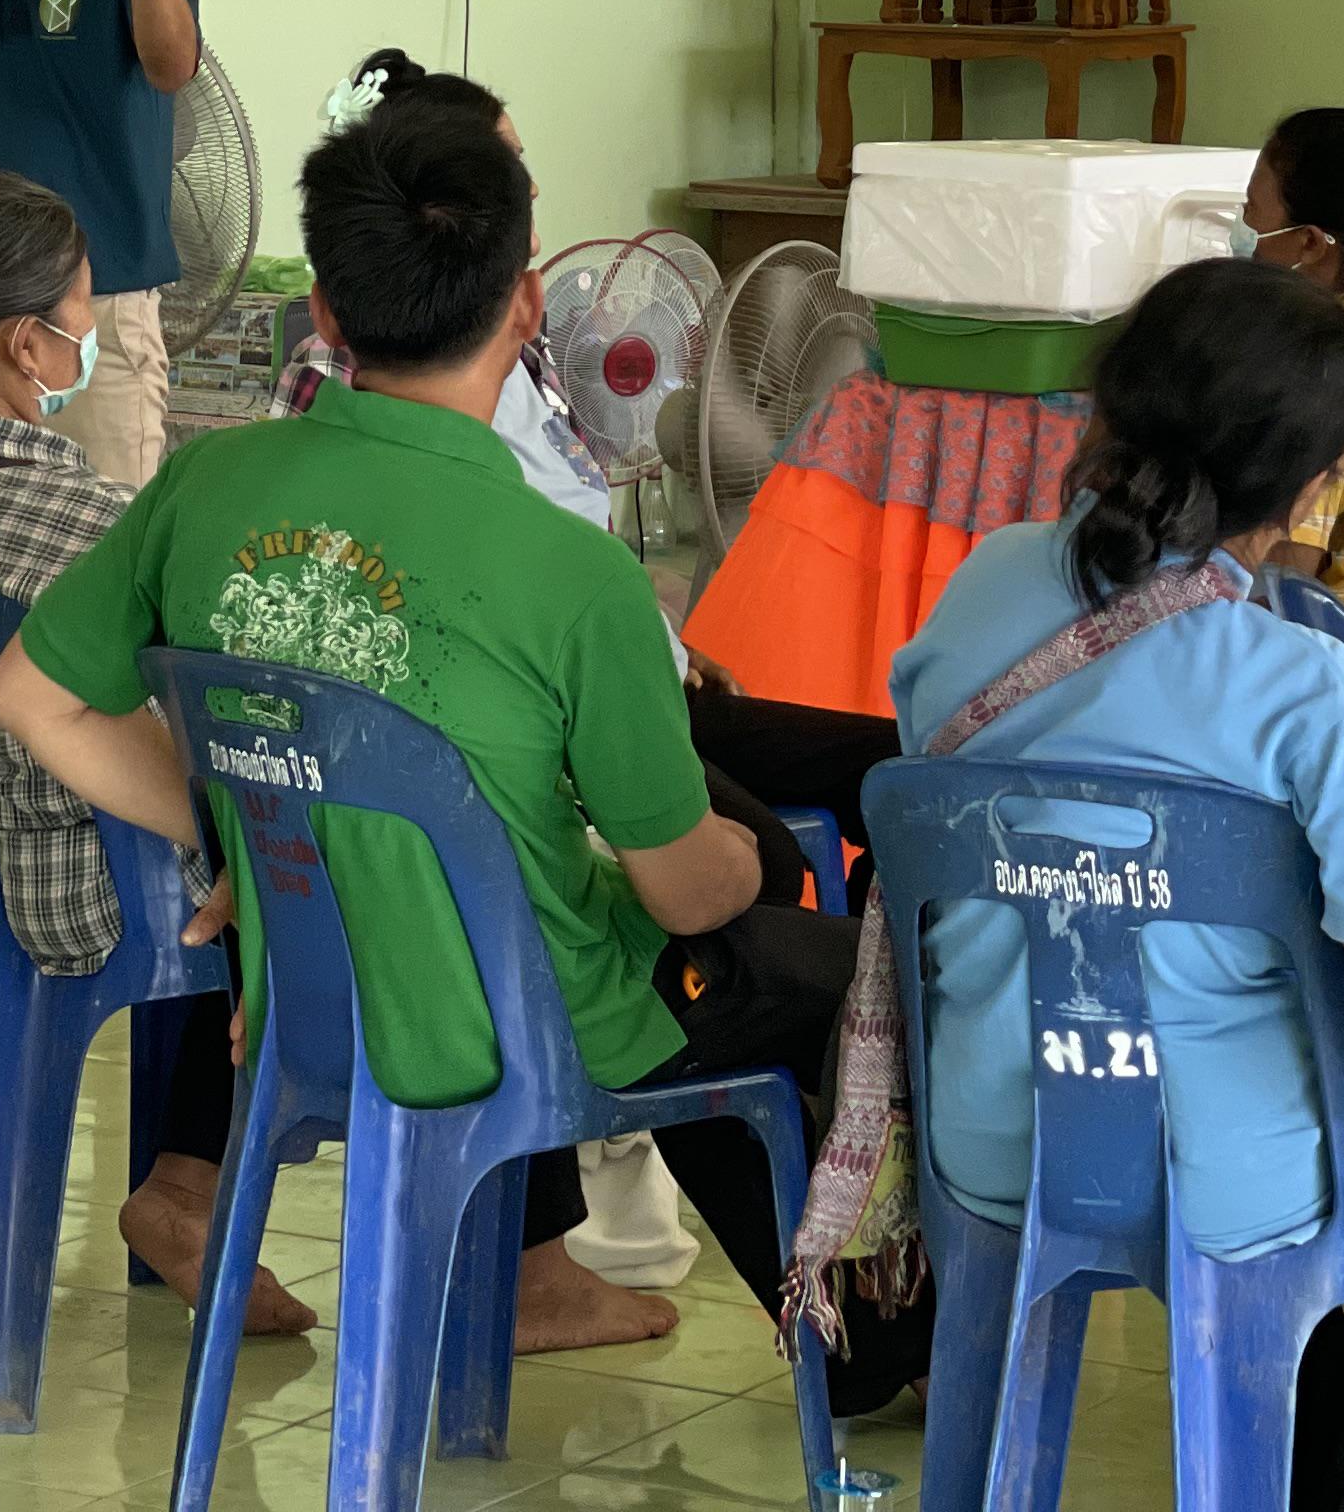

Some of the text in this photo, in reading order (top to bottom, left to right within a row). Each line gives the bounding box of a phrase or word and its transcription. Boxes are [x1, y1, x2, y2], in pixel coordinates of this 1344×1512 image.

[302, 754, 323, 793] 58
[1147, 868, 1172, 910] 58
[1042, 1029, 1159, 1079] ม.21
